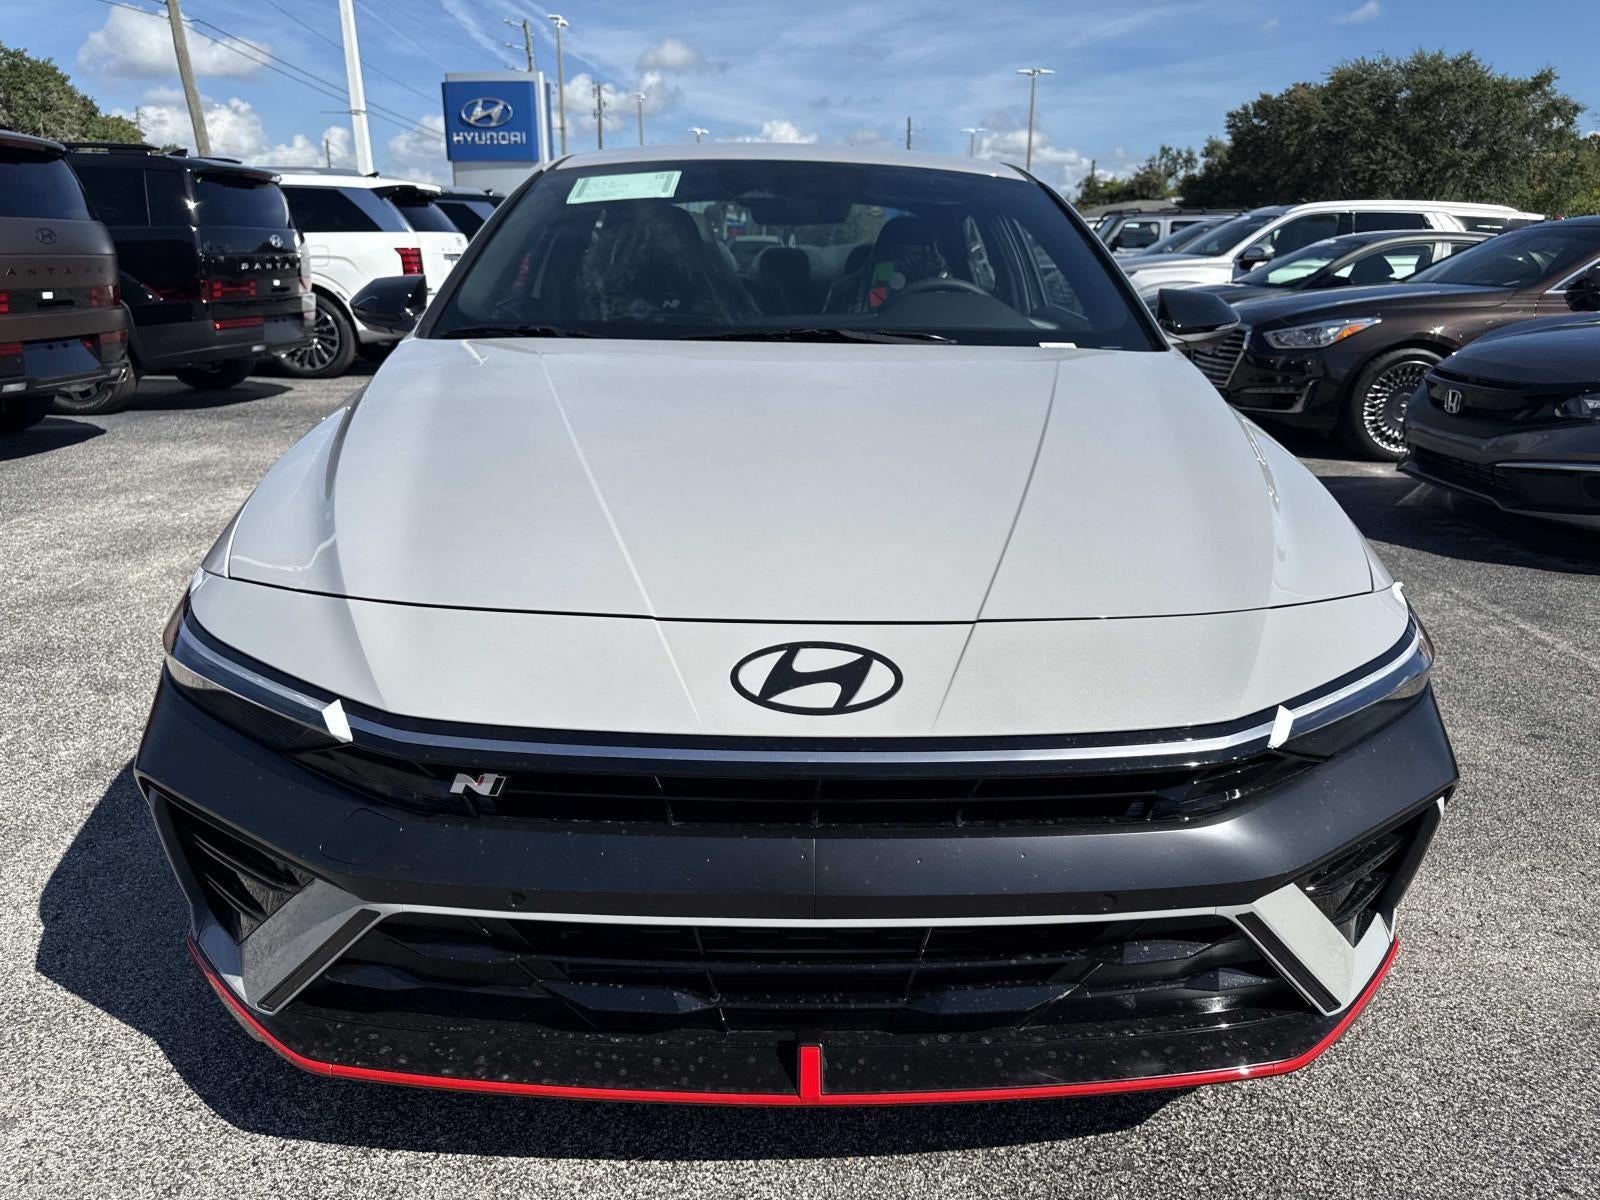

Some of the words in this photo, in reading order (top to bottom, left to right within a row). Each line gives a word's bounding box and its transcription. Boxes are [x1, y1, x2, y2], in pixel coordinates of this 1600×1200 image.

[452, 131, 527, 145] HYUNDAI
[4, 266, 72, 277] ANTA
[241, 262, 290, 270] SANTA
[449, 773, 506, 797] N
